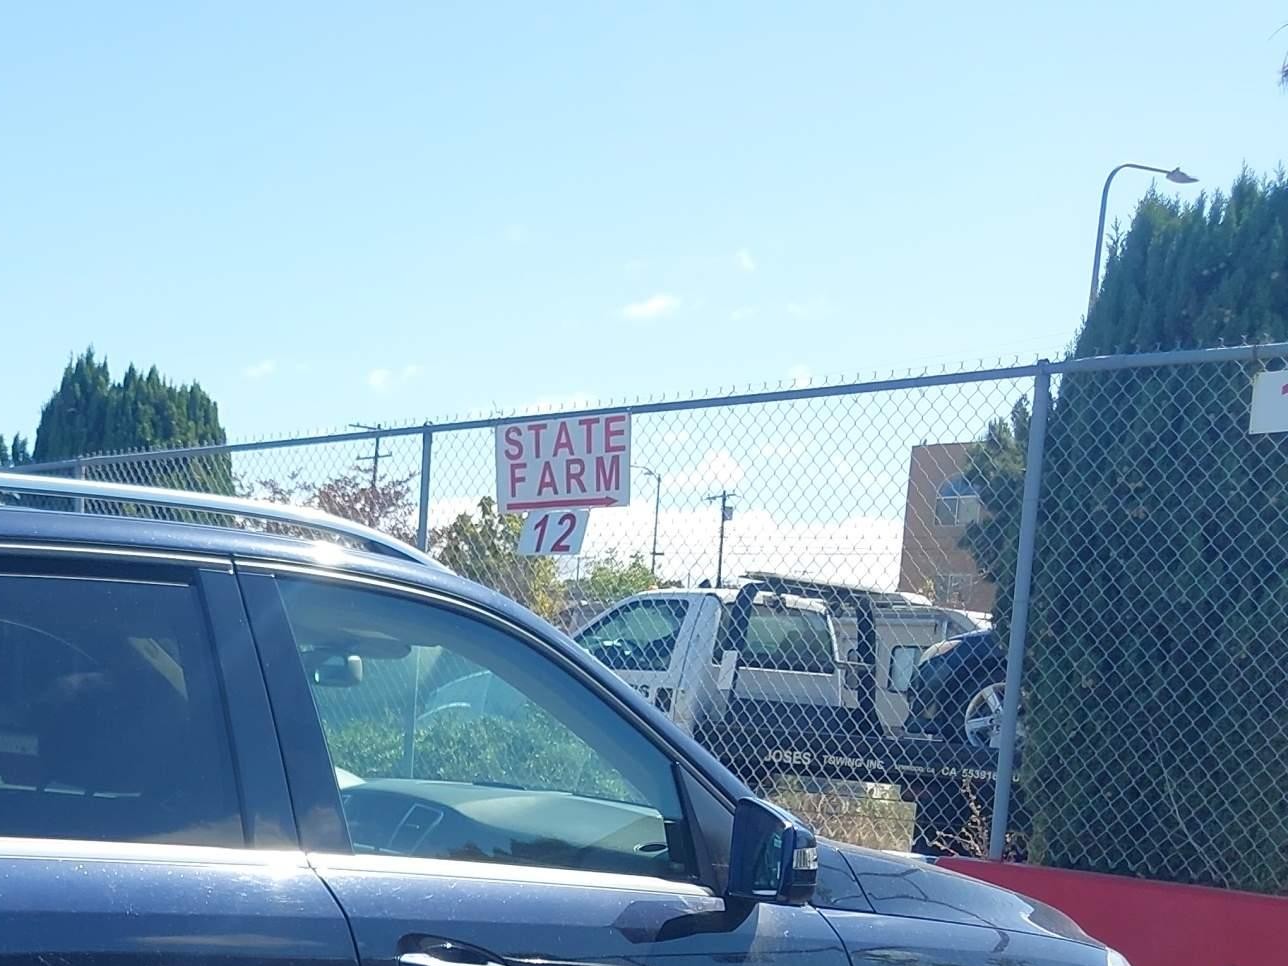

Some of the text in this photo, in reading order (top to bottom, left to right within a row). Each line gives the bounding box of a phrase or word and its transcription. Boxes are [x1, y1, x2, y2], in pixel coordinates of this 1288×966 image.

[504, 416, 626, 461] STATE
[509, 455, 620, 498] FARM
[533, 512, 577, 553] 12
[764, 749, 812, 766] JOSES
[822, 754, 863, 769] TOWING
[866, 759, 885, 770] INC
[941, 766, 958, 777] CA
